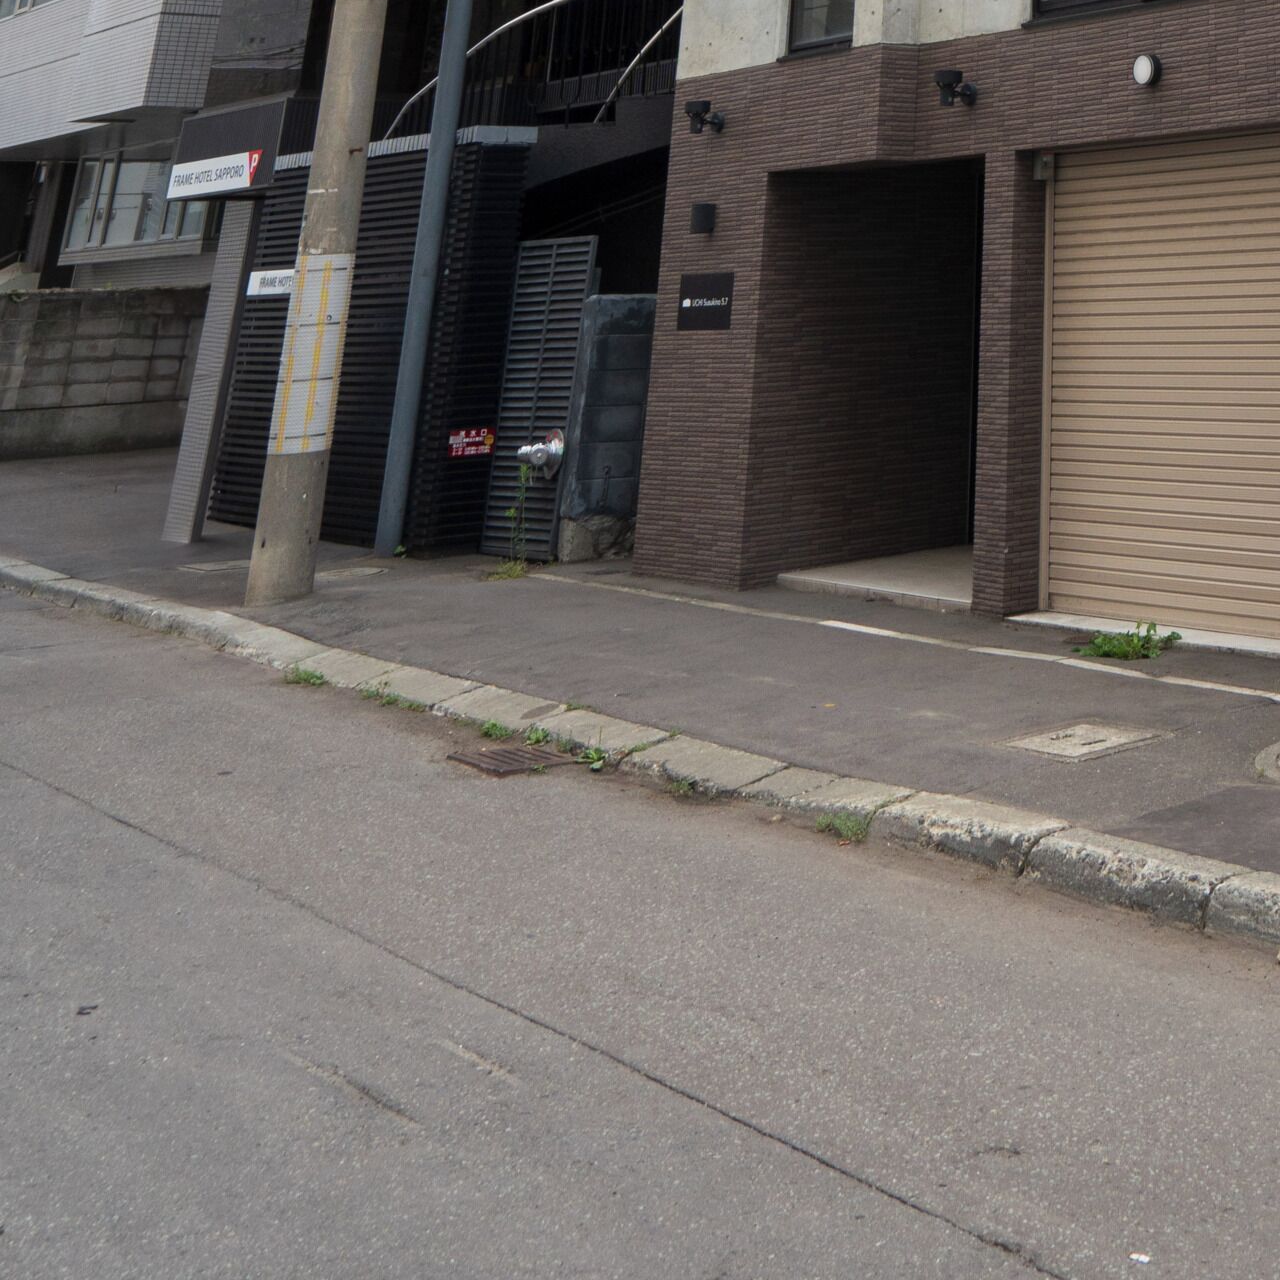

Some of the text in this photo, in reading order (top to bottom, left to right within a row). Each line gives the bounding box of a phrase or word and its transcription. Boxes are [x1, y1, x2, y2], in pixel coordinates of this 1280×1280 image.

[250, 154, 259, 173] P
[173, 164, 245, 188] FRAME HOTEL SAPPORO
[259, 276, 278, 288] FRAME
